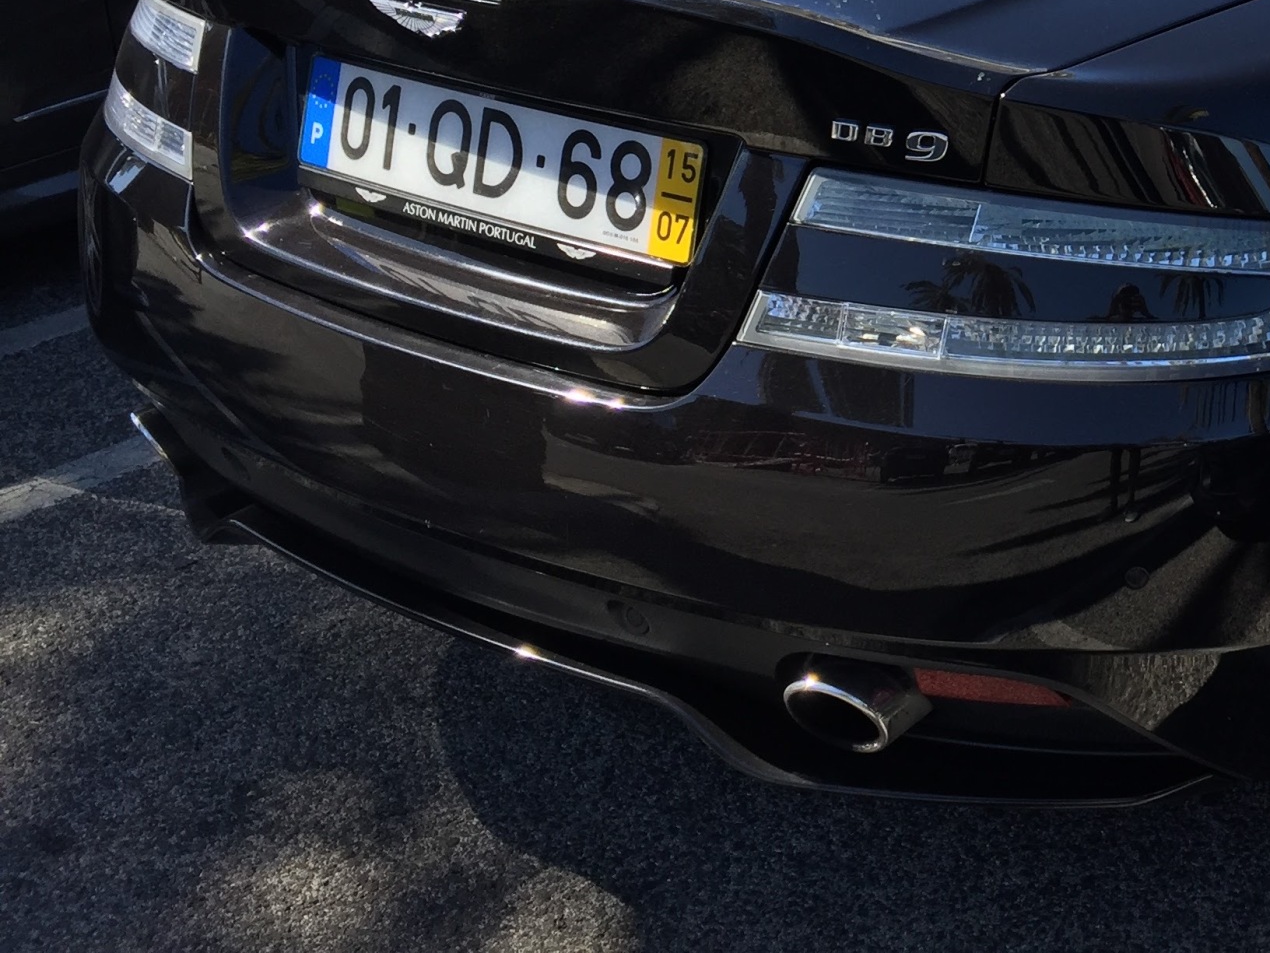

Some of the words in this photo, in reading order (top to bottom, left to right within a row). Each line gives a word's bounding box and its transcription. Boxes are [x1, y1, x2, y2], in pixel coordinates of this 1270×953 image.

[311, 122, 324, 144] P
[831, 120, 949, 162] DB9
[667, 149, 699, 183] 15
[403, 202, 436, 221] ASTON
[438, 211, 477, 233] MARTIN
[479, 222, 537, 249] PORTUGAL
[657, 211, 689, 244] 07
